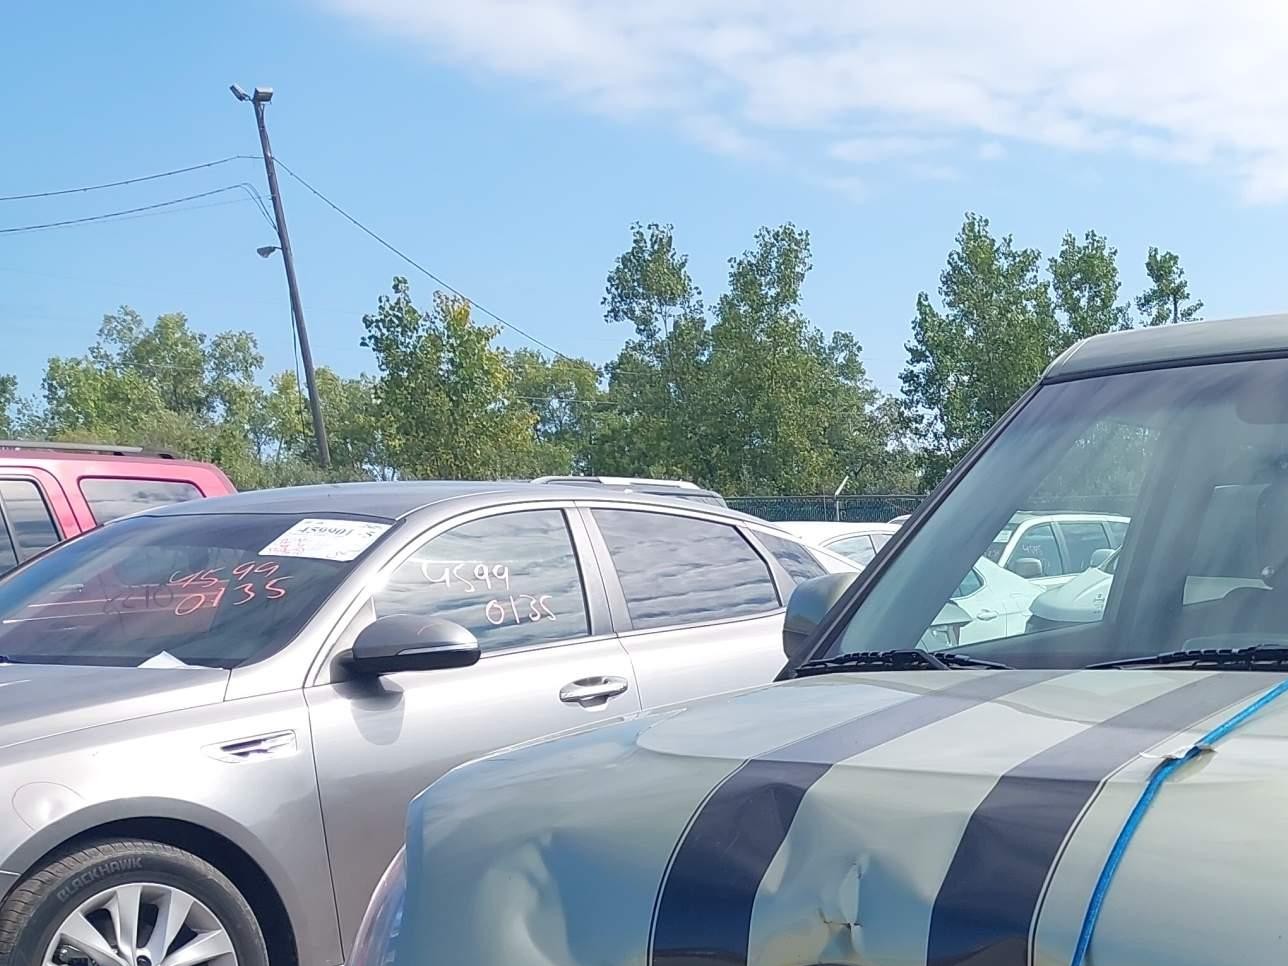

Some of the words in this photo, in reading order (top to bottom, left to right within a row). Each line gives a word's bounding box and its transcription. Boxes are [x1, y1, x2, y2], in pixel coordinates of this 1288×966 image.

[421, 561, 510, 593] 4599
[485, 594, 556, 625] 0135
[56, 857, 143, 902] BLACKHAWK
